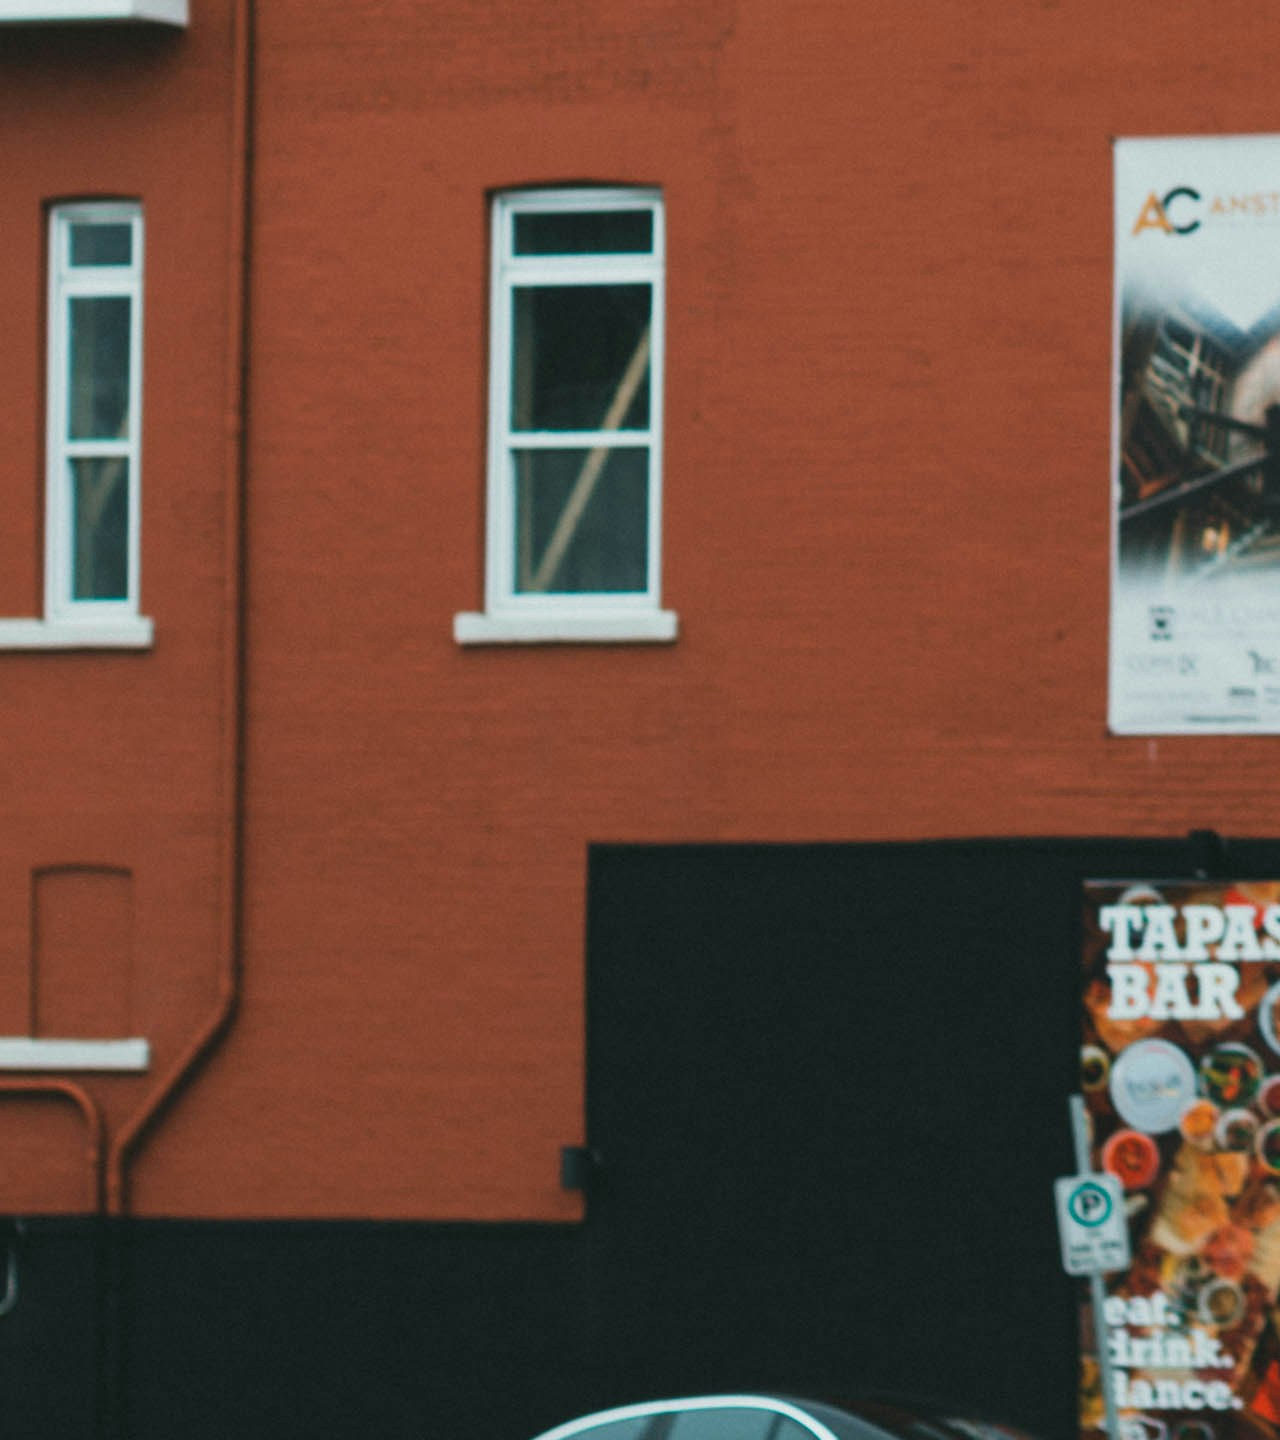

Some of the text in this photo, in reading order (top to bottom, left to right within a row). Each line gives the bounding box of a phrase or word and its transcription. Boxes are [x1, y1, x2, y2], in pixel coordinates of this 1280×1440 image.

[1106, 964, 1246, 1020] BAR
[1080, 1192, 1101, 1216] P
[1103, 1291, 1181, 1326] eat.
[1107, 1328, 1235, 1368] drink.
